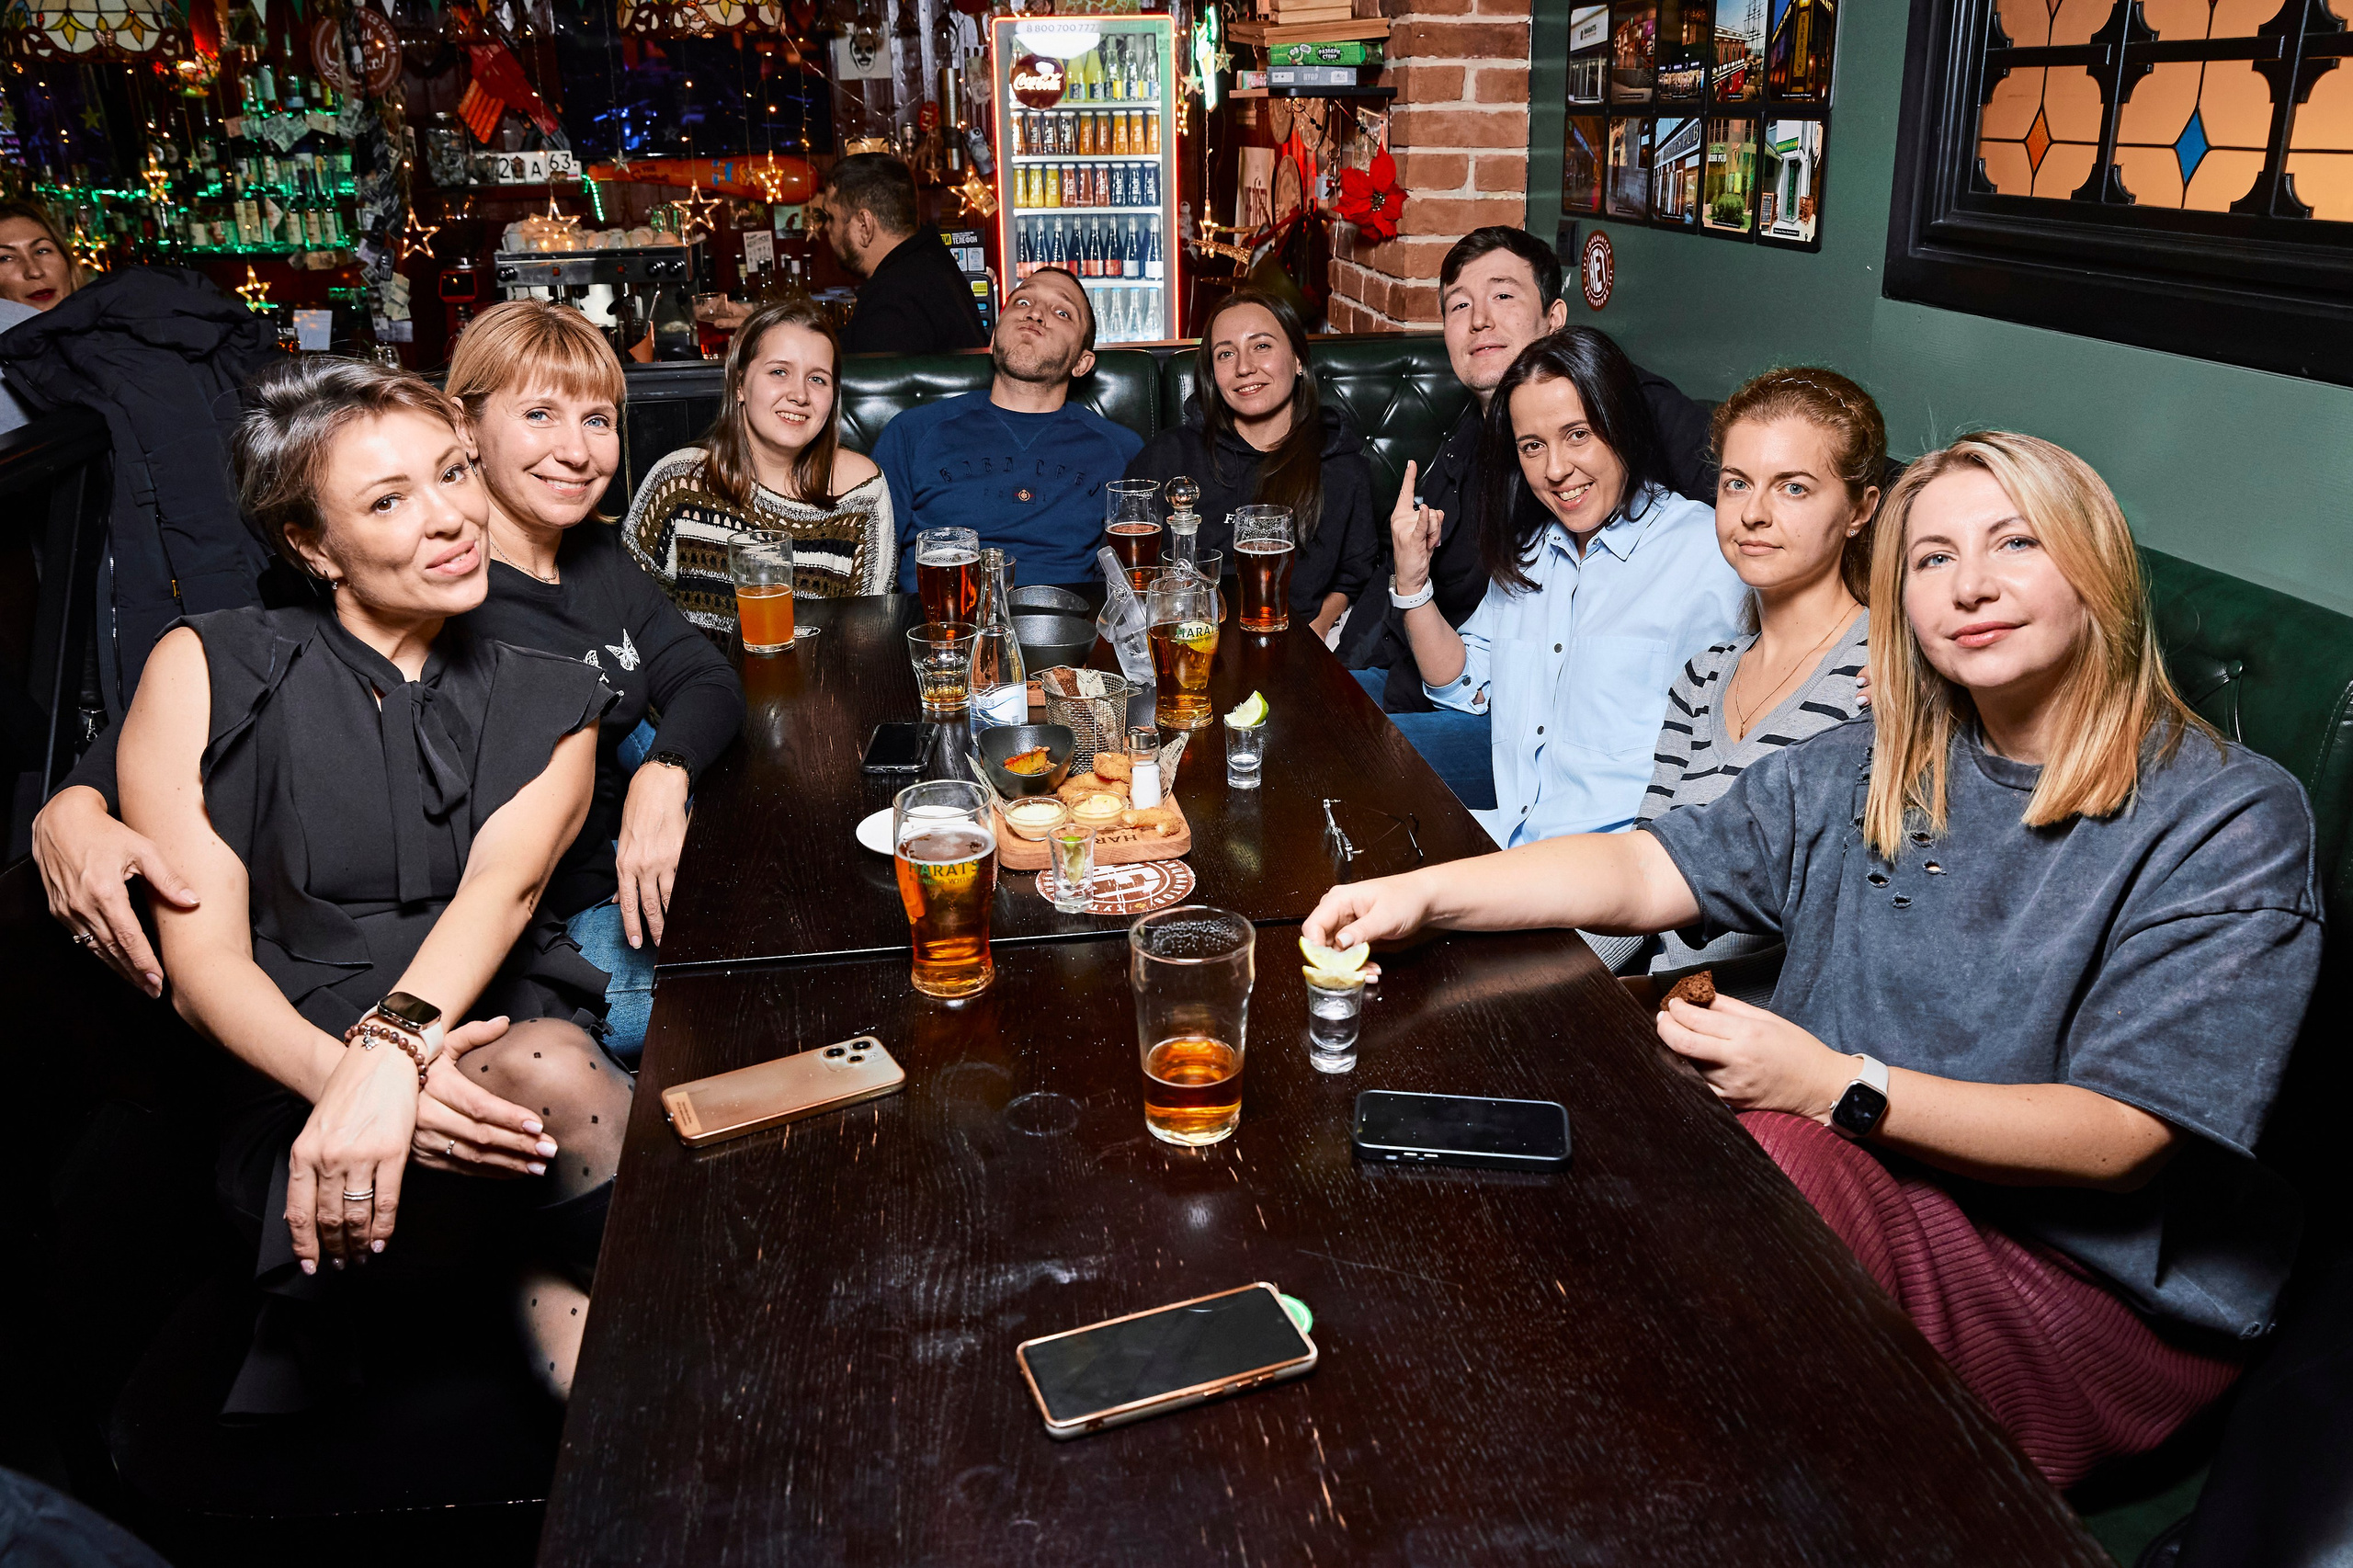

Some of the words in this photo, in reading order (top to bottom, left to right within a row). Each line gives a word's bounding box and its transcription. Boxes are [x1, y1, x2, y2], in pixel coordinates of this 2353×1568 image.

[1026, 24, 1032, 32] 8
[1035, 24, 1055, 32] 800
[1057, 24, 1076, 32] 700
[1318, 47, 1342, 55] РАЗБЕРИ
[1013, 72, 1063, 91] Coca-Cola
[1682, 124, 1699, 148] PUB
[550, 153, 571, 171] 63
[951, 235, 978, 245] ТЕЛЕФОН
[1588, 248, 1607, 293] НЕТ
[907, 858, 980, 877] HARAT'S
